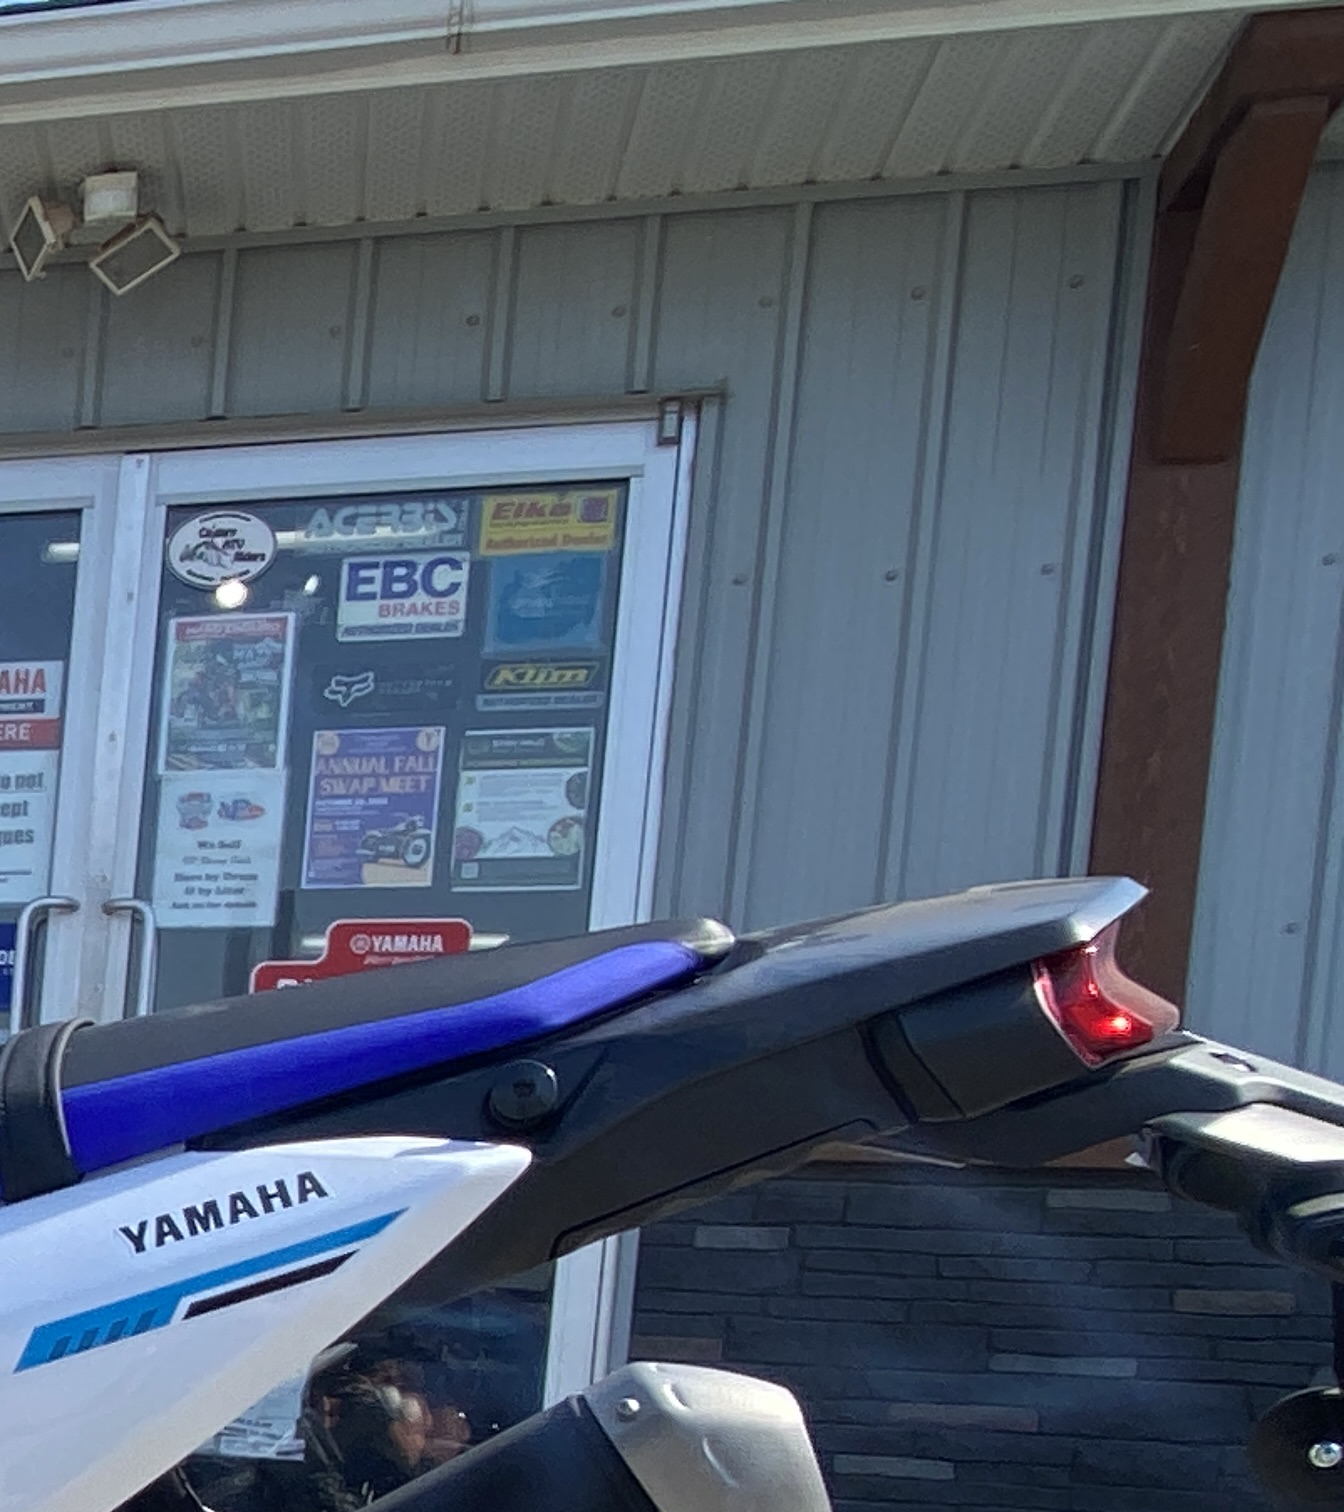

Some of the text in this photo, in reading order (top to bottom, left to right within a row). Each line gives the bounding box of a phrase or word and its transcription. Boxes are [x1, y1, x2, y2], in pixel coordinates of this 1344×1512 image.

[345, 556, 464, 602] EBC
[378, 600, 461, 618] BRAKES
[315, 755, 437, 775] ANNUAL FALL
[319, 775, 432, 796] SWAP MEET
[371, 934, 444, 953] YAMAHA
[119, 1170, 330, 1256] YAMAHA
